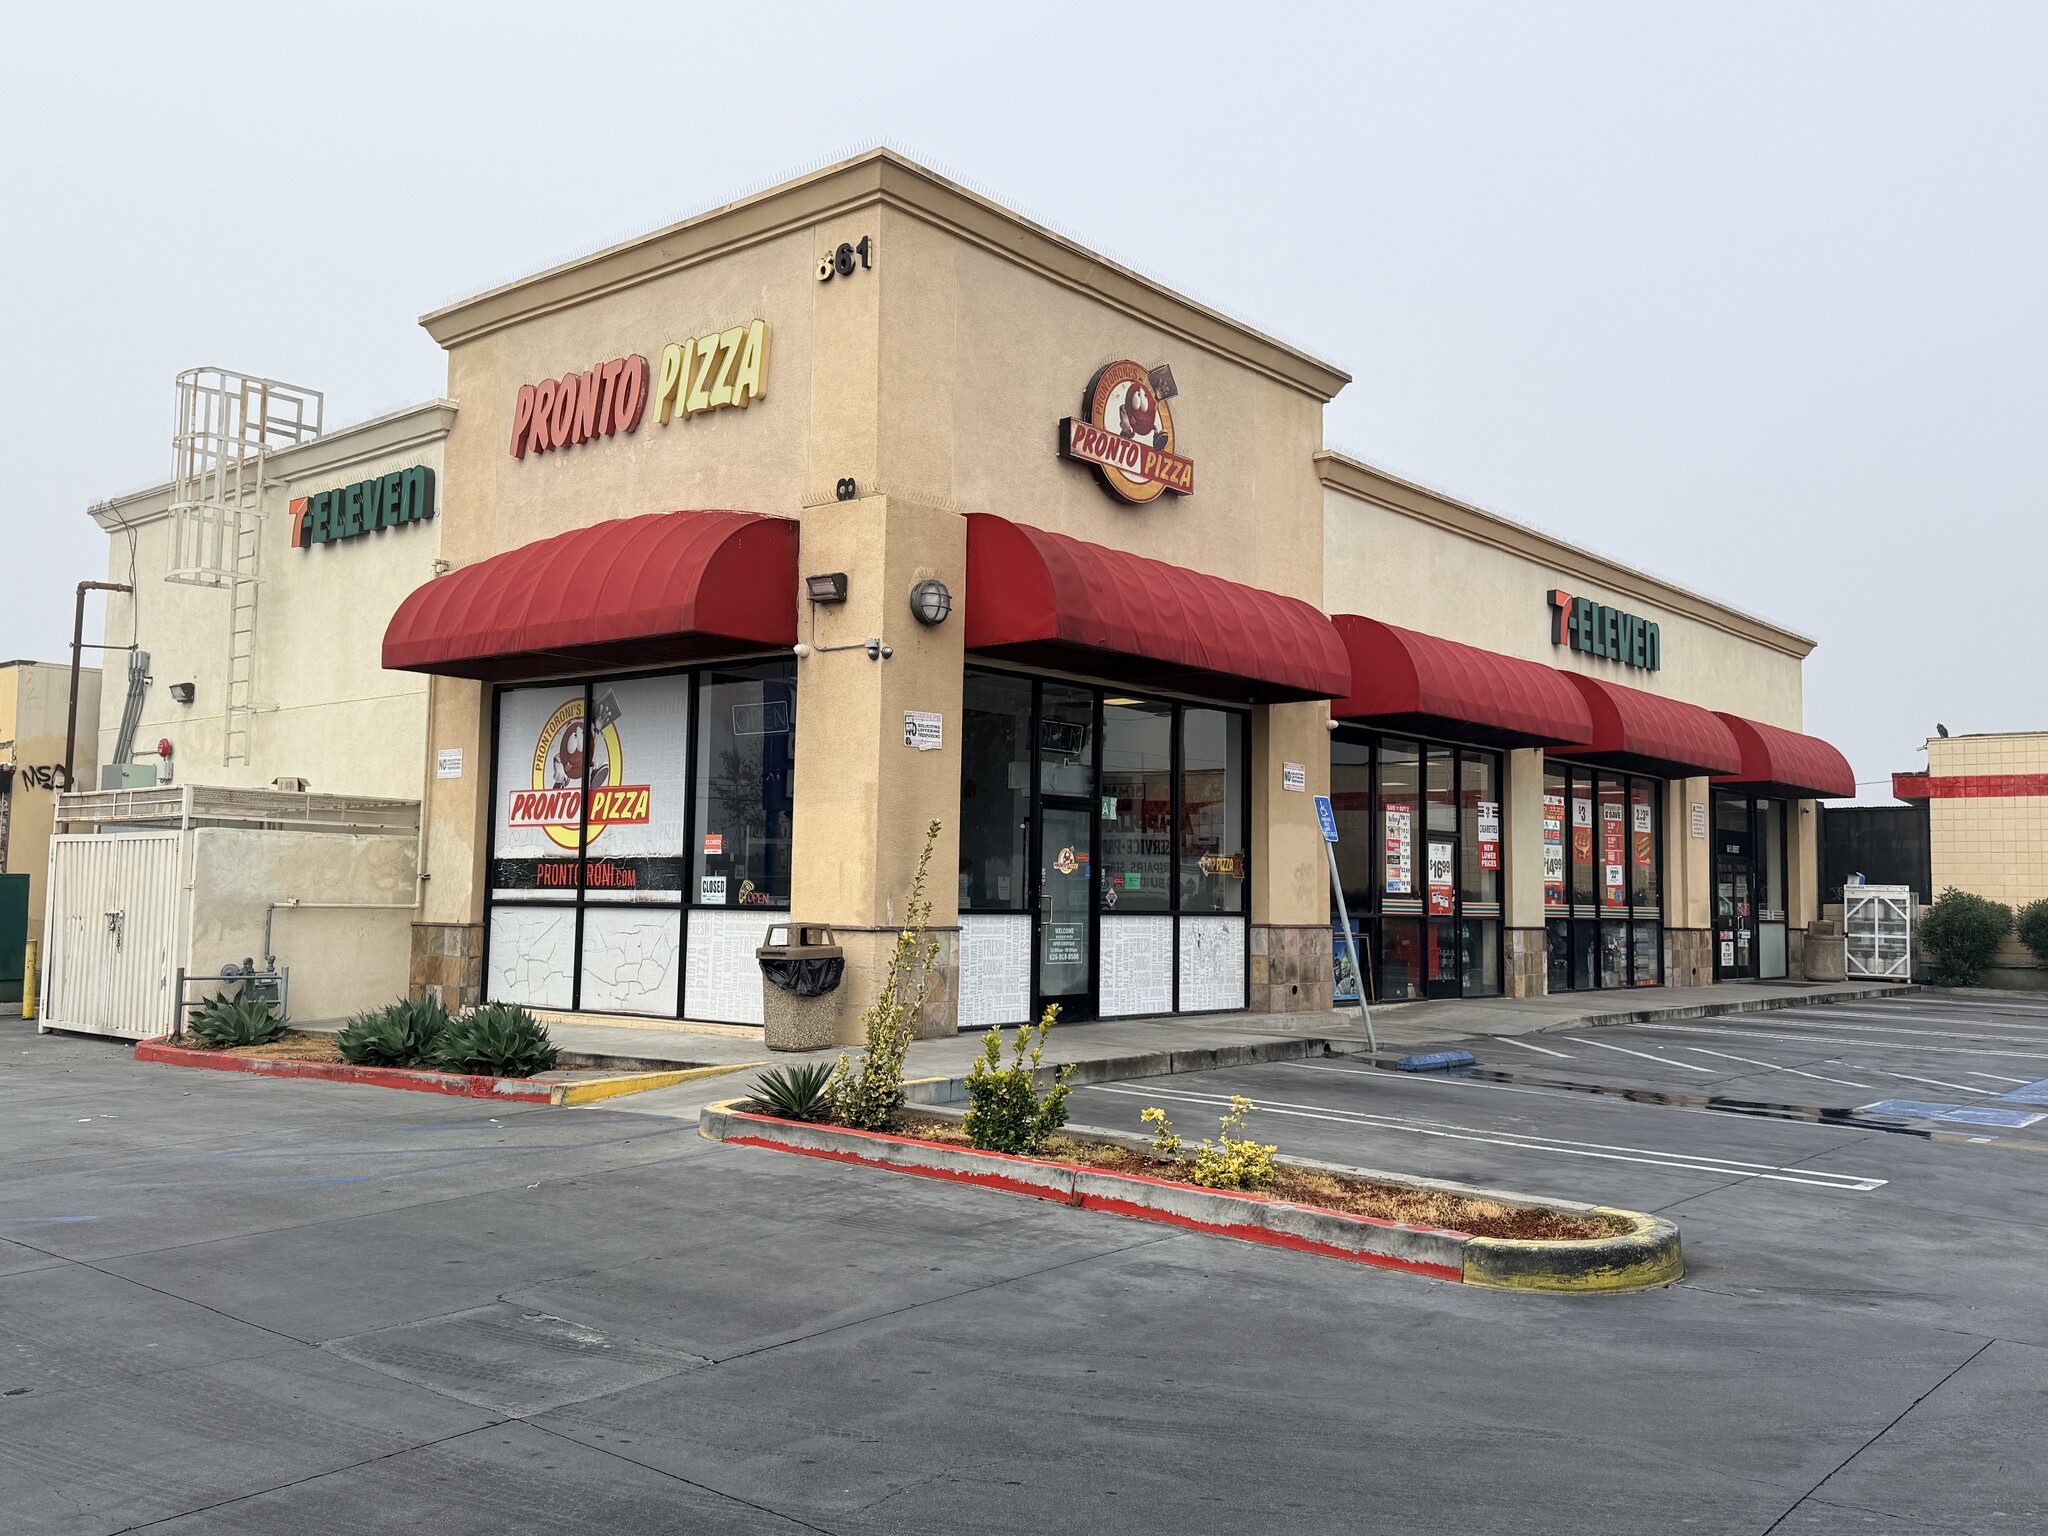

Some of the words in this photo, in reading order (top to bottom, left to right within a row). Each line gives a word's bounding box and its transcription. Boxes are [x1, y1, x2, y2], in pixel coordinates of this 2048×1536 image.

[509, 354, 649, 459] PRONTO
[652, 319, 772, 425] PIZZA
[1095, 365, 1138, 415] PRONTORONI'S
[1072, 424, 1139, 468] PRONTO
[1145, 451, 1192, 488] PIZZA
[535, 703, 582, 772] PRONTORONI'S
[439, 759, 447, 770] NO
[511, 791, 581, 821] PRONTO
[590, 790, 649, 820] PIZZA
[1102, 802, 1109, 816] A
[1609, 811, 1621, 819] SAVE
[1216, 858, 1233, 871] PIZZA
[703, 880, 725, 893] CLOSED
[748, 892, 769, 904] OPEN
[712, 941, 722, 990] PEPPERONI
[724, 937, 732, 972] NATURAL
[984, 940, 1003, 956] FRESH
[1020, 941, 1030, 993] ALWAYS
[1164, 940, 1172, 986] ALWAYS
[1183, 948, 1191, 985] PIZZA
[687, 948, 696, 988] PRONTO
[696, 947, 709, 988] PIZZA
[723, 974, 731, 991] ALL
[961, 945, 969, 995] PEPPERONI
[1103, 949, 1113, 988] PIZZA
